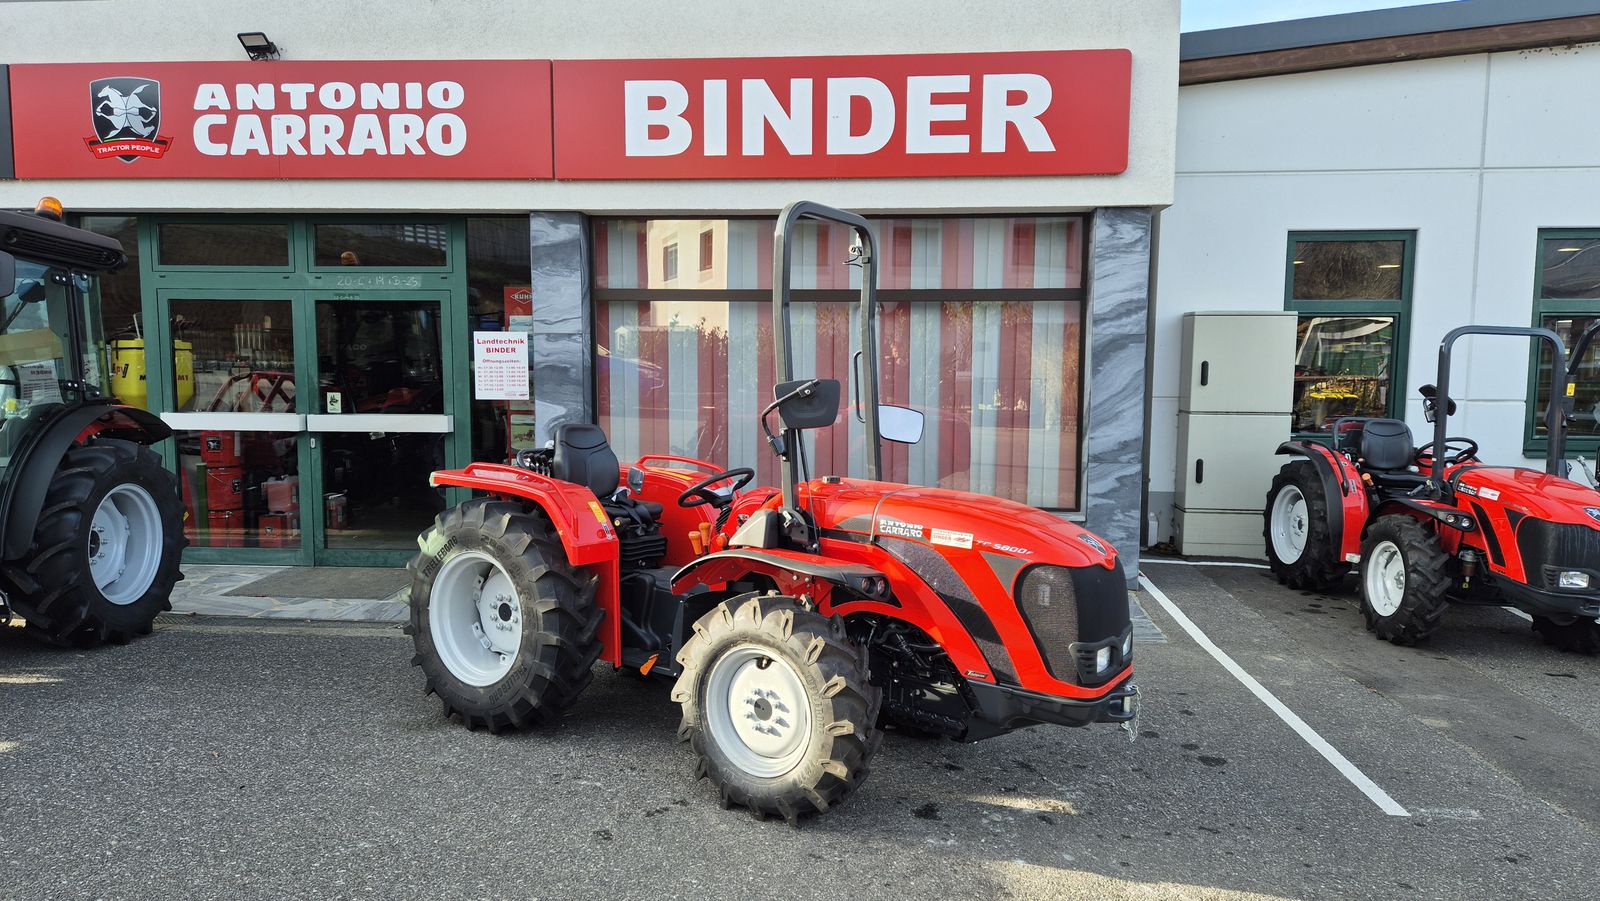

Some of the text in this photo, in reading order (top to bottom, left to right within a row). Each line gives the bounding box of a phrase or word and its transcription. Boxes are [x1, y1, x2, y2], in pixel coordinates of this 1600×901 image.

[193, 81, 465, 110] ANTONIO
[623, 73, 1057, 156] BINDER
[193, 113, 467, 157] CARRARO
[97, 144, 160, 154] TRACTOR PEOPLE
[879, 519, 924, 530] ANTONIO
[879, 525, 923, 538] CARRARO
